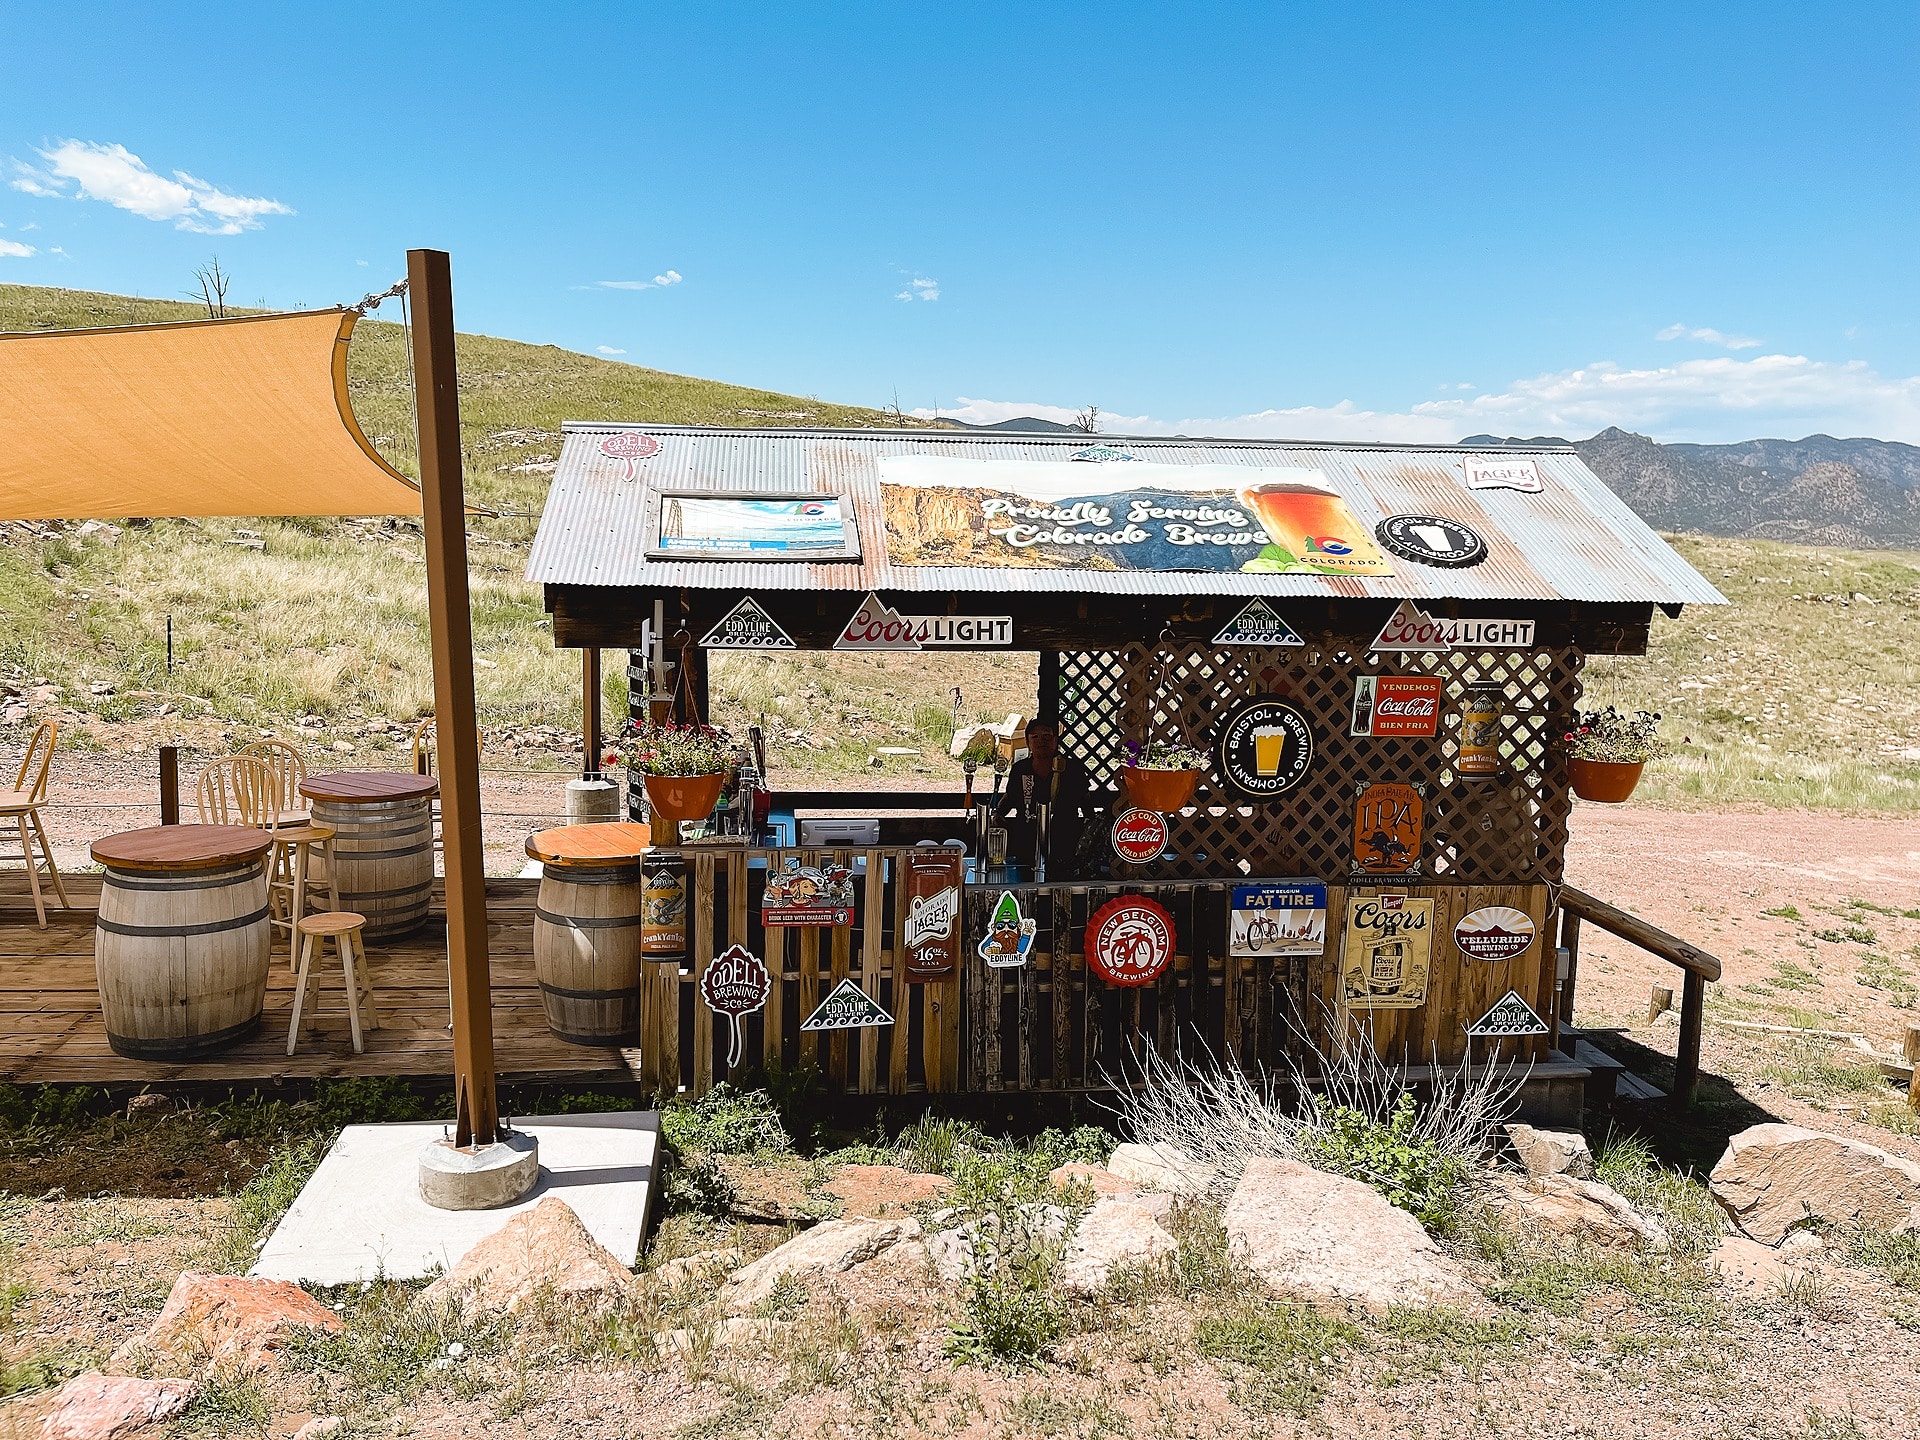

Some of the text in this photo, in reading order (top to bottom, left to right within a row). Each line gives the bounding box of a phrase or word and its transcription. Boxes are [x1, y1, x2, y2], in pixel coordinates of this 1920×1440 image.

[607, 435, 652, 447] ODELL
[981, 499, 1249, 527] Proudly Serving
[989, 523, 1271, 547] Colorado Brews
[1434, 519, 1475, 547] BREWING
[1403, 541, 1465, 558] COMPANY
[1300, 557, 1377, 565] COLORADO
[725, 620, 771, 632] EDDYLINE
[843, 609, 1010, 642] Coors LIGHT
[1237, 619, 1280, 630] EDDYLINE
[1380, 612, 1532, 643] Coors LIGHT
[1229, 708, 1308, 770] BRISTOL BREWING
[1231, 763, 1286, 790] COMPANY
[1364, 786, 1415, 802] INDIA PALE ALE
[1123, 812, 1158, 825] ICE COLD
[1360, 798, 1418, 837] IPA
[1121, 845, 1158, 858] SOLD HERE
[914, 895, 949, 920] COLORADO
[1245, 894, 1314, 906] FAT TIRE
[914, 903, 949, 939] LAGER
[1354, 902, 1427, 930] Coors
[1100, 911, 1166, 946] NEW BELGIUM
[1460, 936, 1529, 944] TELLURIDE
[1469, 944, 1509, 952] BREWING
[990, 953, 1023, 963] EDDYLINE
[711, 957, 761, 988] ODELL
[1108, 967, 1155, 980] BREWING
[712, 985, 760, 1000] BREWING
[825, 1001, 870, 1014] EDDYLINE
[1491, 1011, 1530, 1022] EDDYLINE
